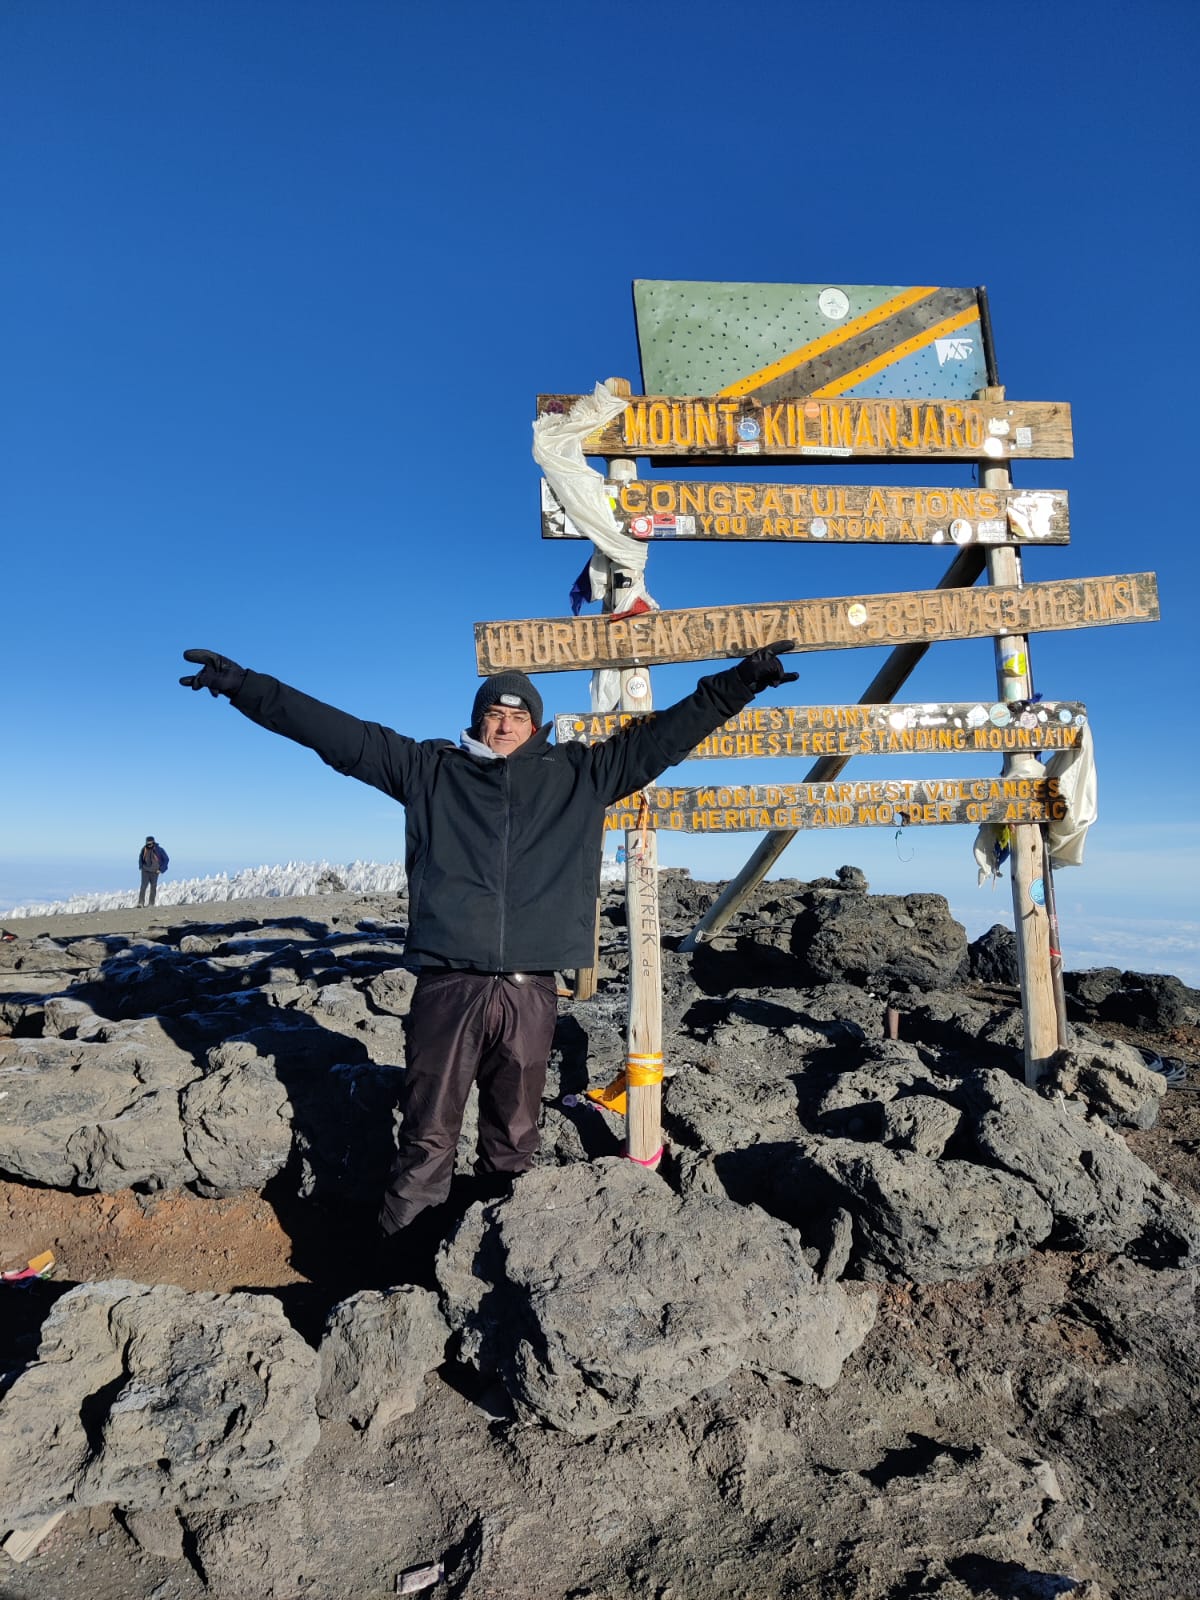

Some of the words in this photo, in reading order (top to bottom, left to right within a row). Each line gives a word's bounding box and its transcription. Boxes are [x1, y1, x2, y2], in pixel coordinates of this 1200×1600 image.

[624, 402, 739, 447] MOUNT
[763, 404, 984, 449] KILIMANJARO
[620, 483, 1000, 519] CONGRATULATIONS
[701, 515, 748, 536] YOU
[761, 517, 809, 538] ARE
[827, 520, 886, 540] NOW
[900, 521, 928, 541] AT
[487, 619, 596, 668] UHURU
[1083, 579, 1150, 621] AMSL
[806, 708, 871, 730] POINT
[696, 731, 796, 756] HIGHEST
[974, 725, 1078, 750] MOUNTAIN
[657, 789, 687, 809] OF
[806, 782, 914, 805] LARGEST
[692, 807, 803, 830] HERITAGE
[812, 804, 850, 826] AND
[966, 802, 993, 822] OF
